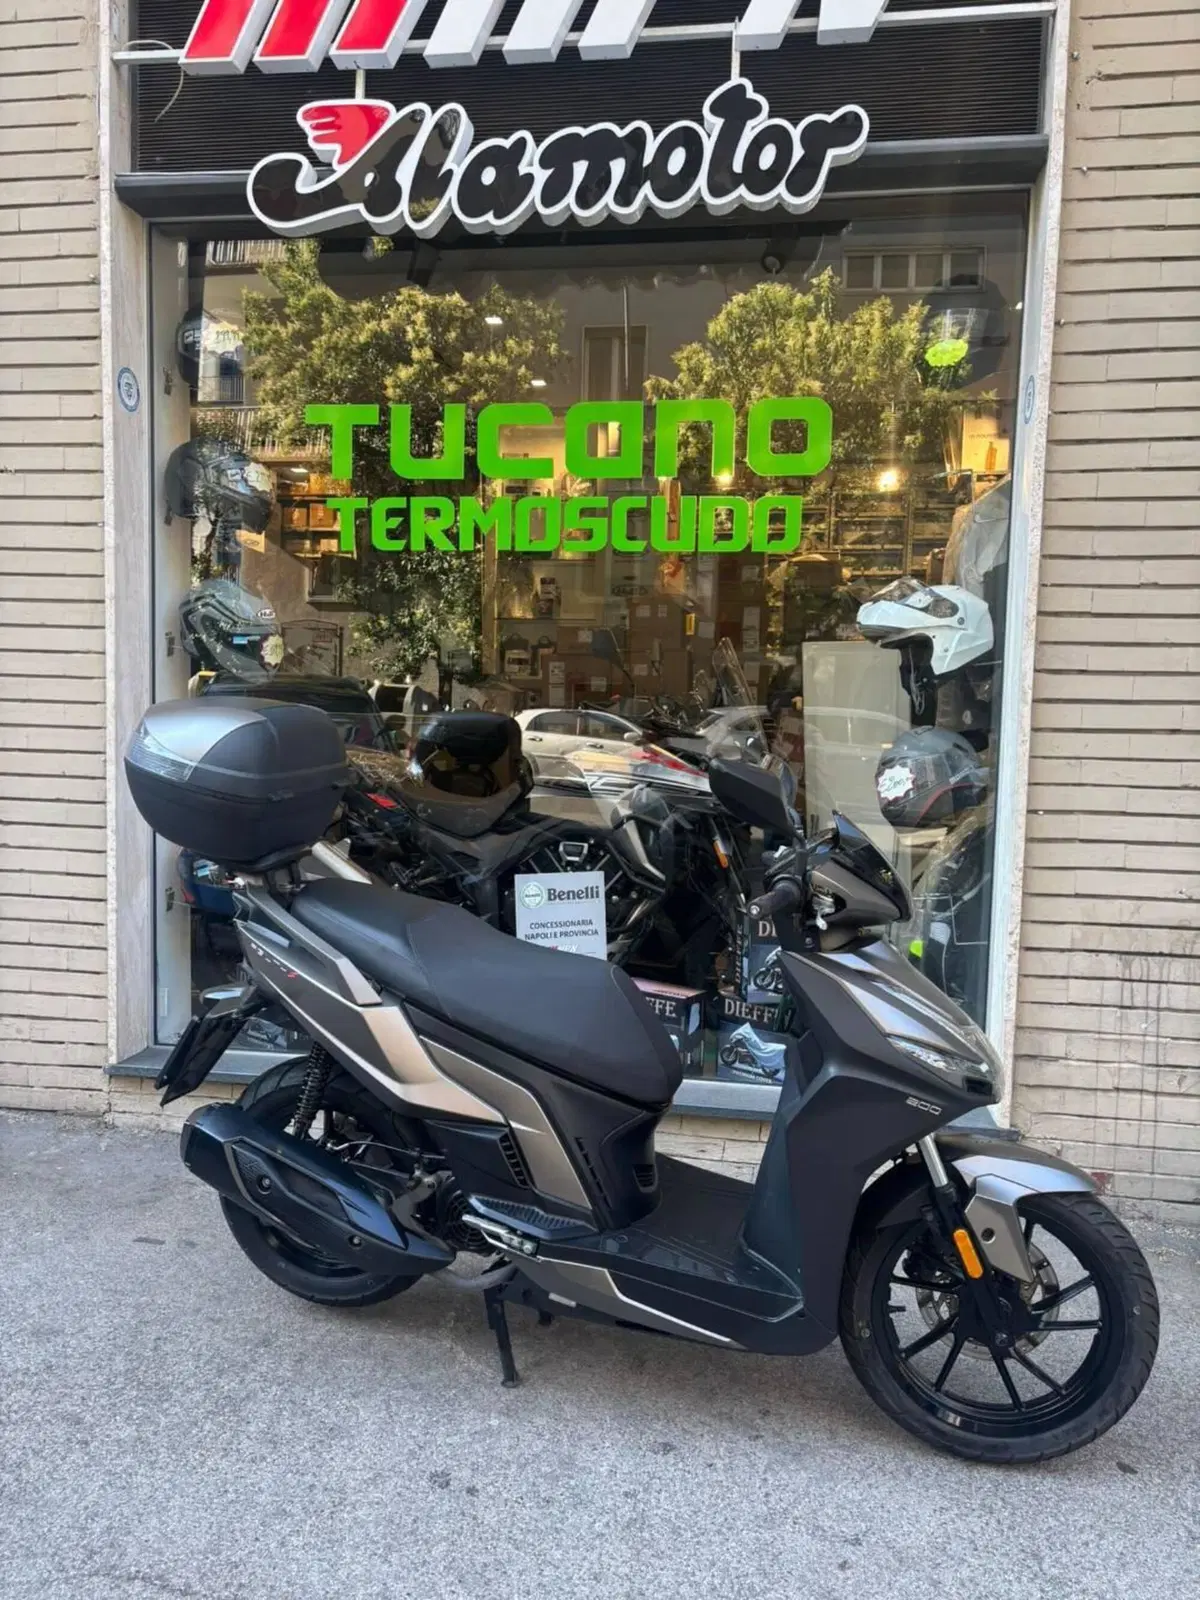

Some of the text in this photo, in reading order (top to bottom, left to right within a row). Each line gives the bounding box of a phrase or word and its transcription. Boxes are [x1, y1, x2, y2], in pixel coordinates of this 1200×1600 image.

[326, 495, 802, 552] TERMOSCUDO
[547, 885, 600, 901] Benelli
[529, 918, 594, 930] CONCESSIONARIA
[524, 931, 552, 941] NAPOLI
[559, 928, 599, 938] PROVINCIA
[724, 998, 779, 1024] DIEFF
[906, 1096, 942, 1115] 200
